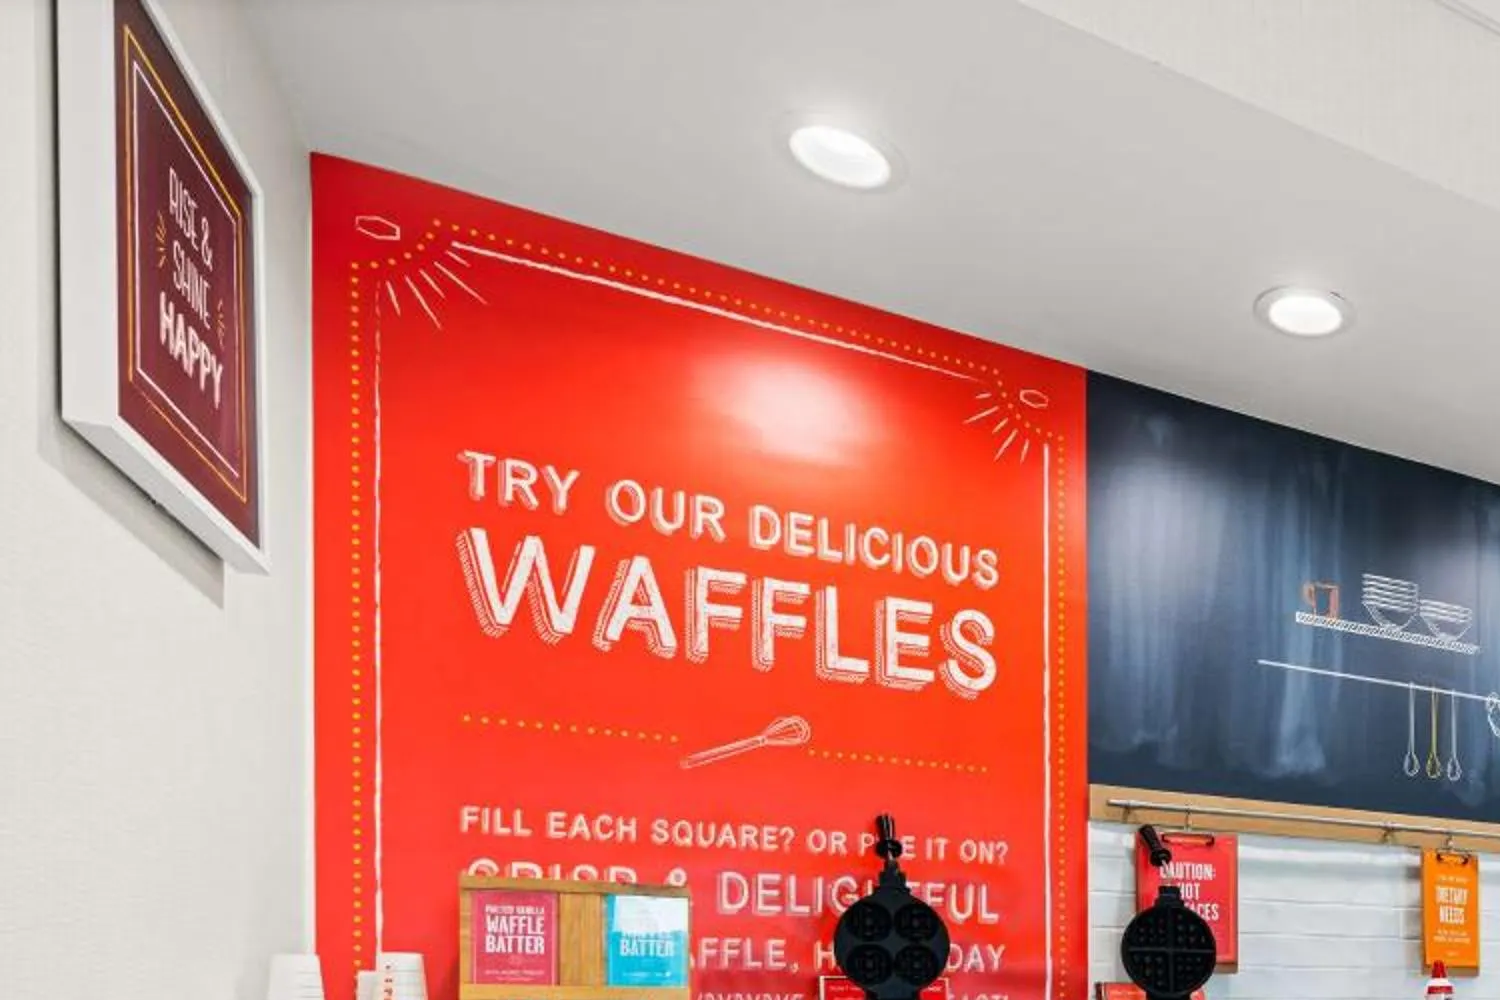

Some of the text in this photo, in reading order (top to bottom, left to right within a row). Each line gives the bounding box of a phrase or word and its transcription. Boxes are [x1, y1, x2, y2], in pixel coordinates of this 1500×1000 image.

[173, 240, 210, 330] SHINE
[160, 291, 223, 409] HAPPY
[459, 450, 999, 589] TRY OUR DELICIOUS
[458, 527, 998, 700] WAFFLES
[459, 805, 1009, 864] FILL EACH SQUARE? OR PE IT ON?
[485, 914, 545, 935] WAFFLE
[717, 870, 1000, 925] DELIGFUL
[485, 935, 545, 955] BATTER
